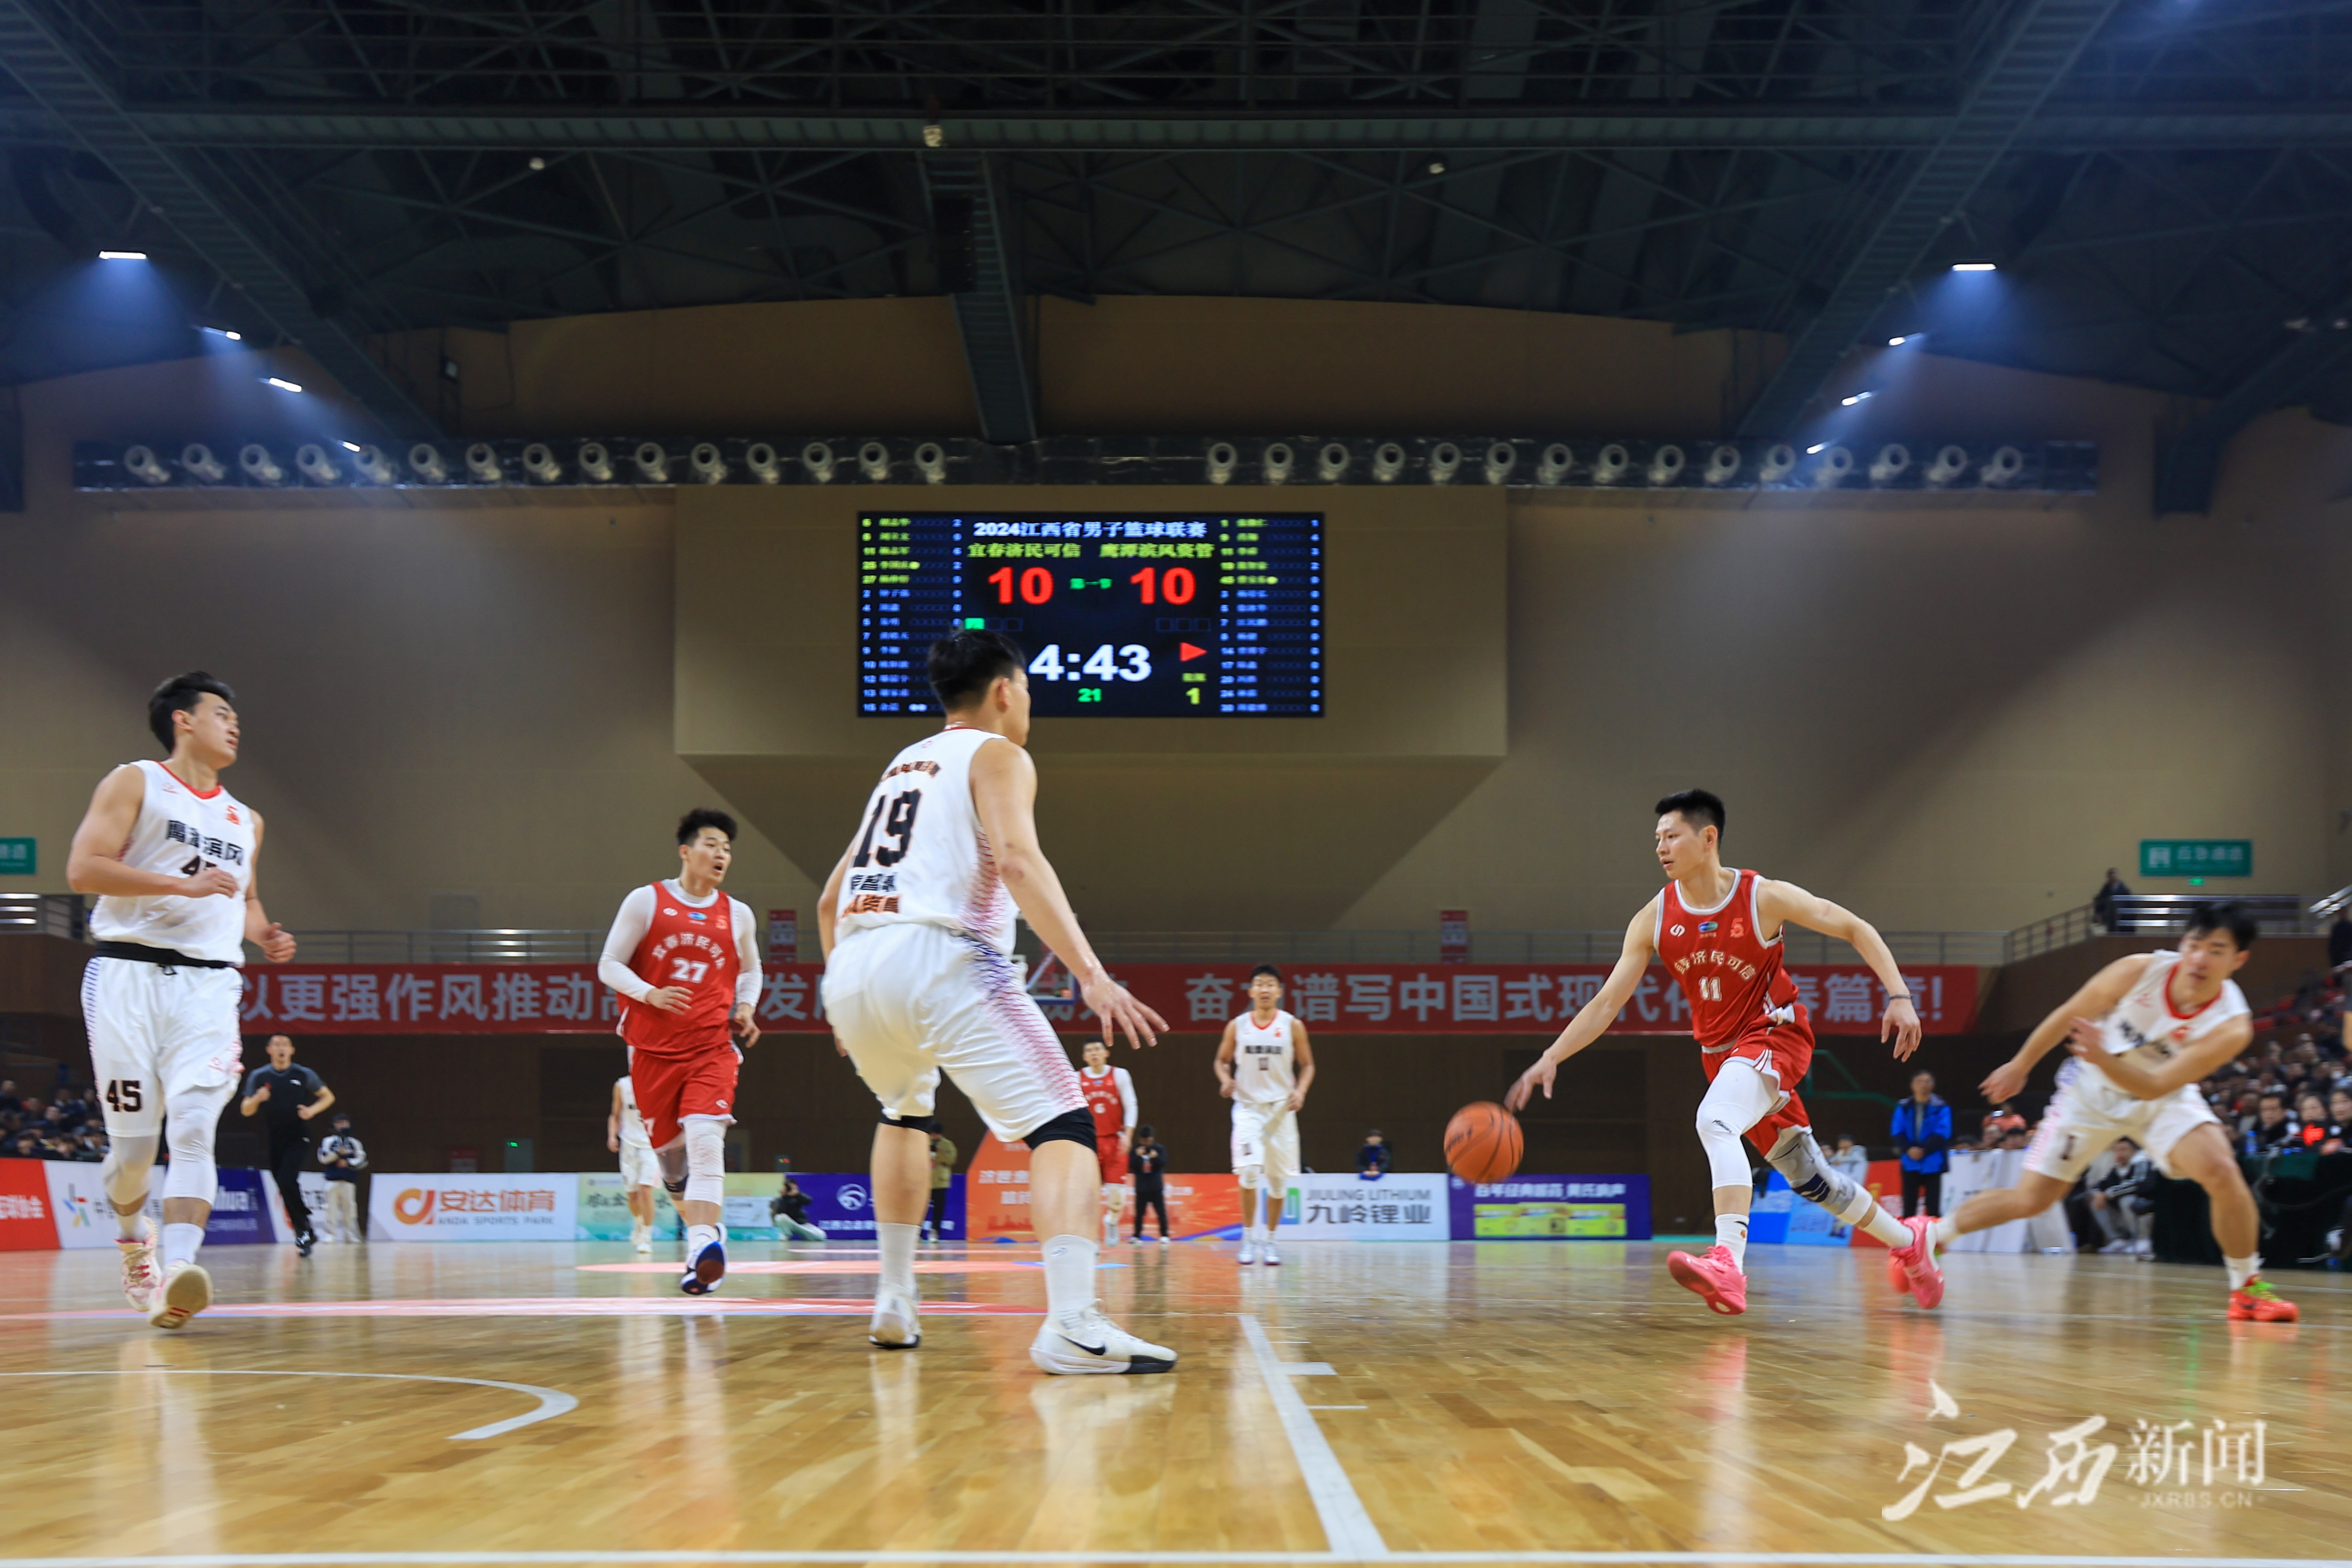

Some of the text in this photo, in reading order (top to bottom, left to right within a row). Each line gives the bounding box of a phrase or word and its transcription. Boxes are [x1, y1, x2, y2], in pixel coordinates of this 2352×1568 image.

[973, 522, 1208, 538] 2024江西省男子篮球联赛
[988, 566, 1054, 605] 10
[1130, 566, 1196, 605] 10
[1028, 644, 1152, 682] 4:43
[1077, 688, 1102, 702] 21
[1186, 687, 1200, 705] 1
[853, 788, 922, 868] 19
[181, 855, 217, 876] 4
[669, 957, 709, 984] 27
[1699, 976, 1722, 1001] 11
[106, 1080, 141, 1112] 45
[439, 1190, 555, 1212] 安达体育
[1368, 1189, 1431, 1200] LITHIUM
[1307, 1204, 1432, 1224] 九岭锂业
